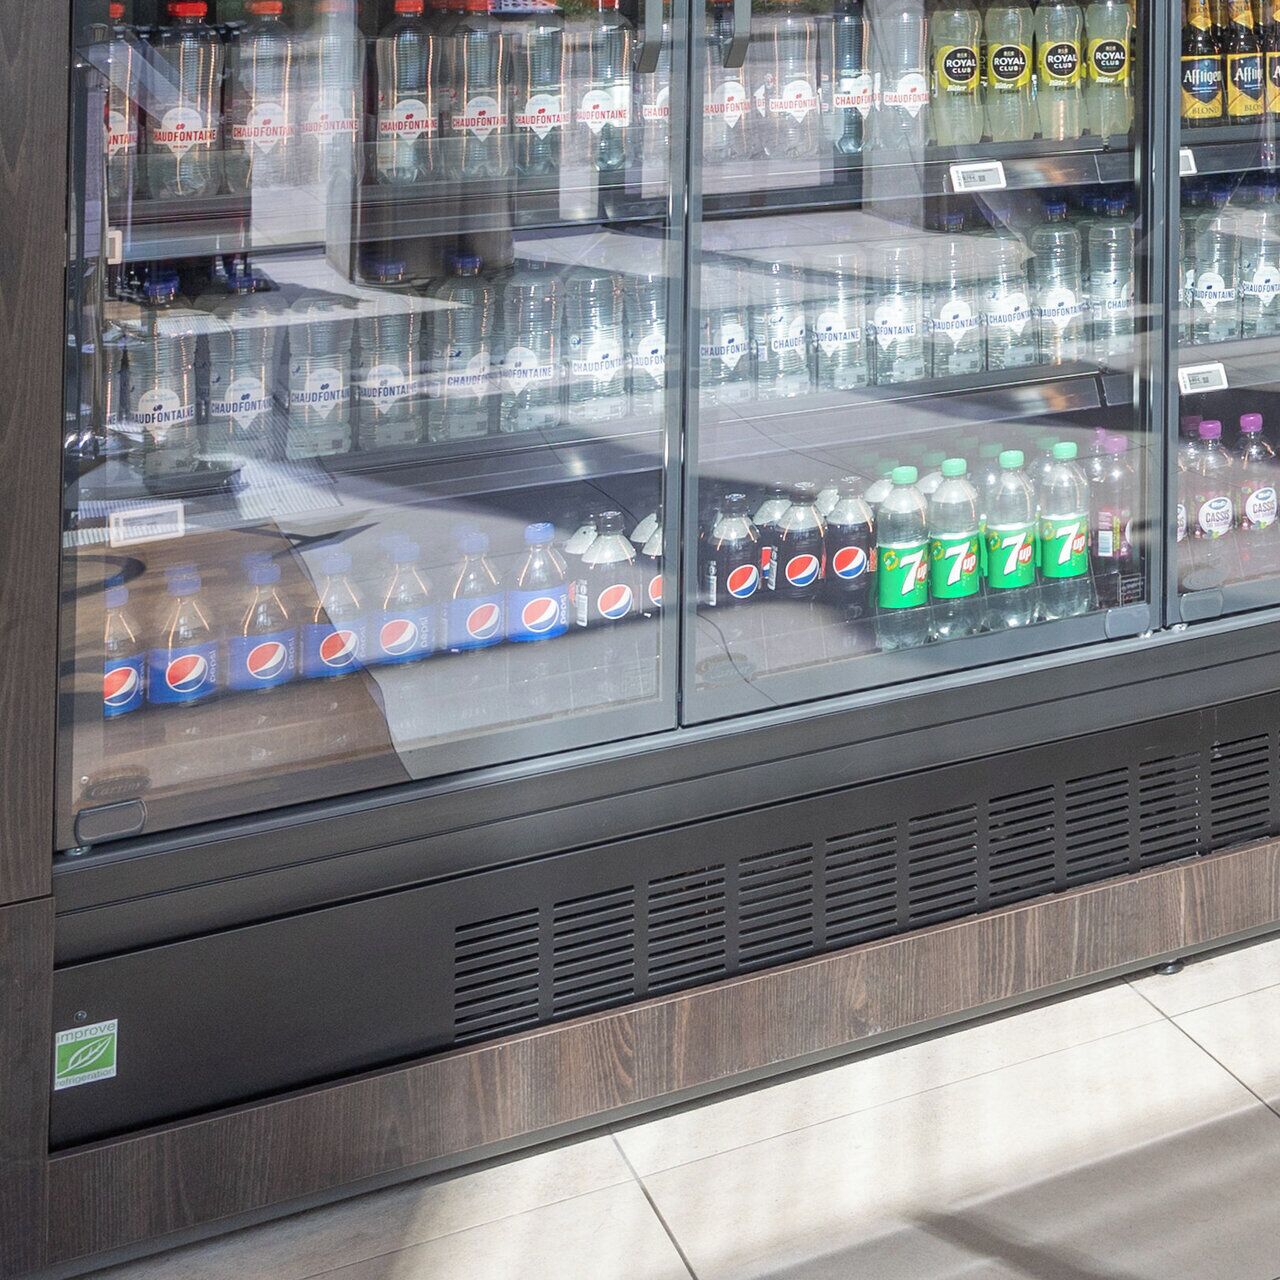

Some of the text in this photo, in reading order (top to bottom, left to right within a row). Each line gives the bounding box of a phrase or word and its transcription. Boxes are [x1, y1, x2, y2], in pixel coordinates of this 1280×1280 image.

[1047, 54, 1078, 63] ROYAL
[1095, 52, 1125, 60] ROYAL
[946, 59, 976, 67] ROYAL
[994, 57, 1025, 66] ROYAL
[1191, 106, 1219, 114] BLOND
[559, 594, 567, 625] pepsi
[56, 1021, 116, 1044] improve
[55, 1068, 115, 1088] refrigeration
